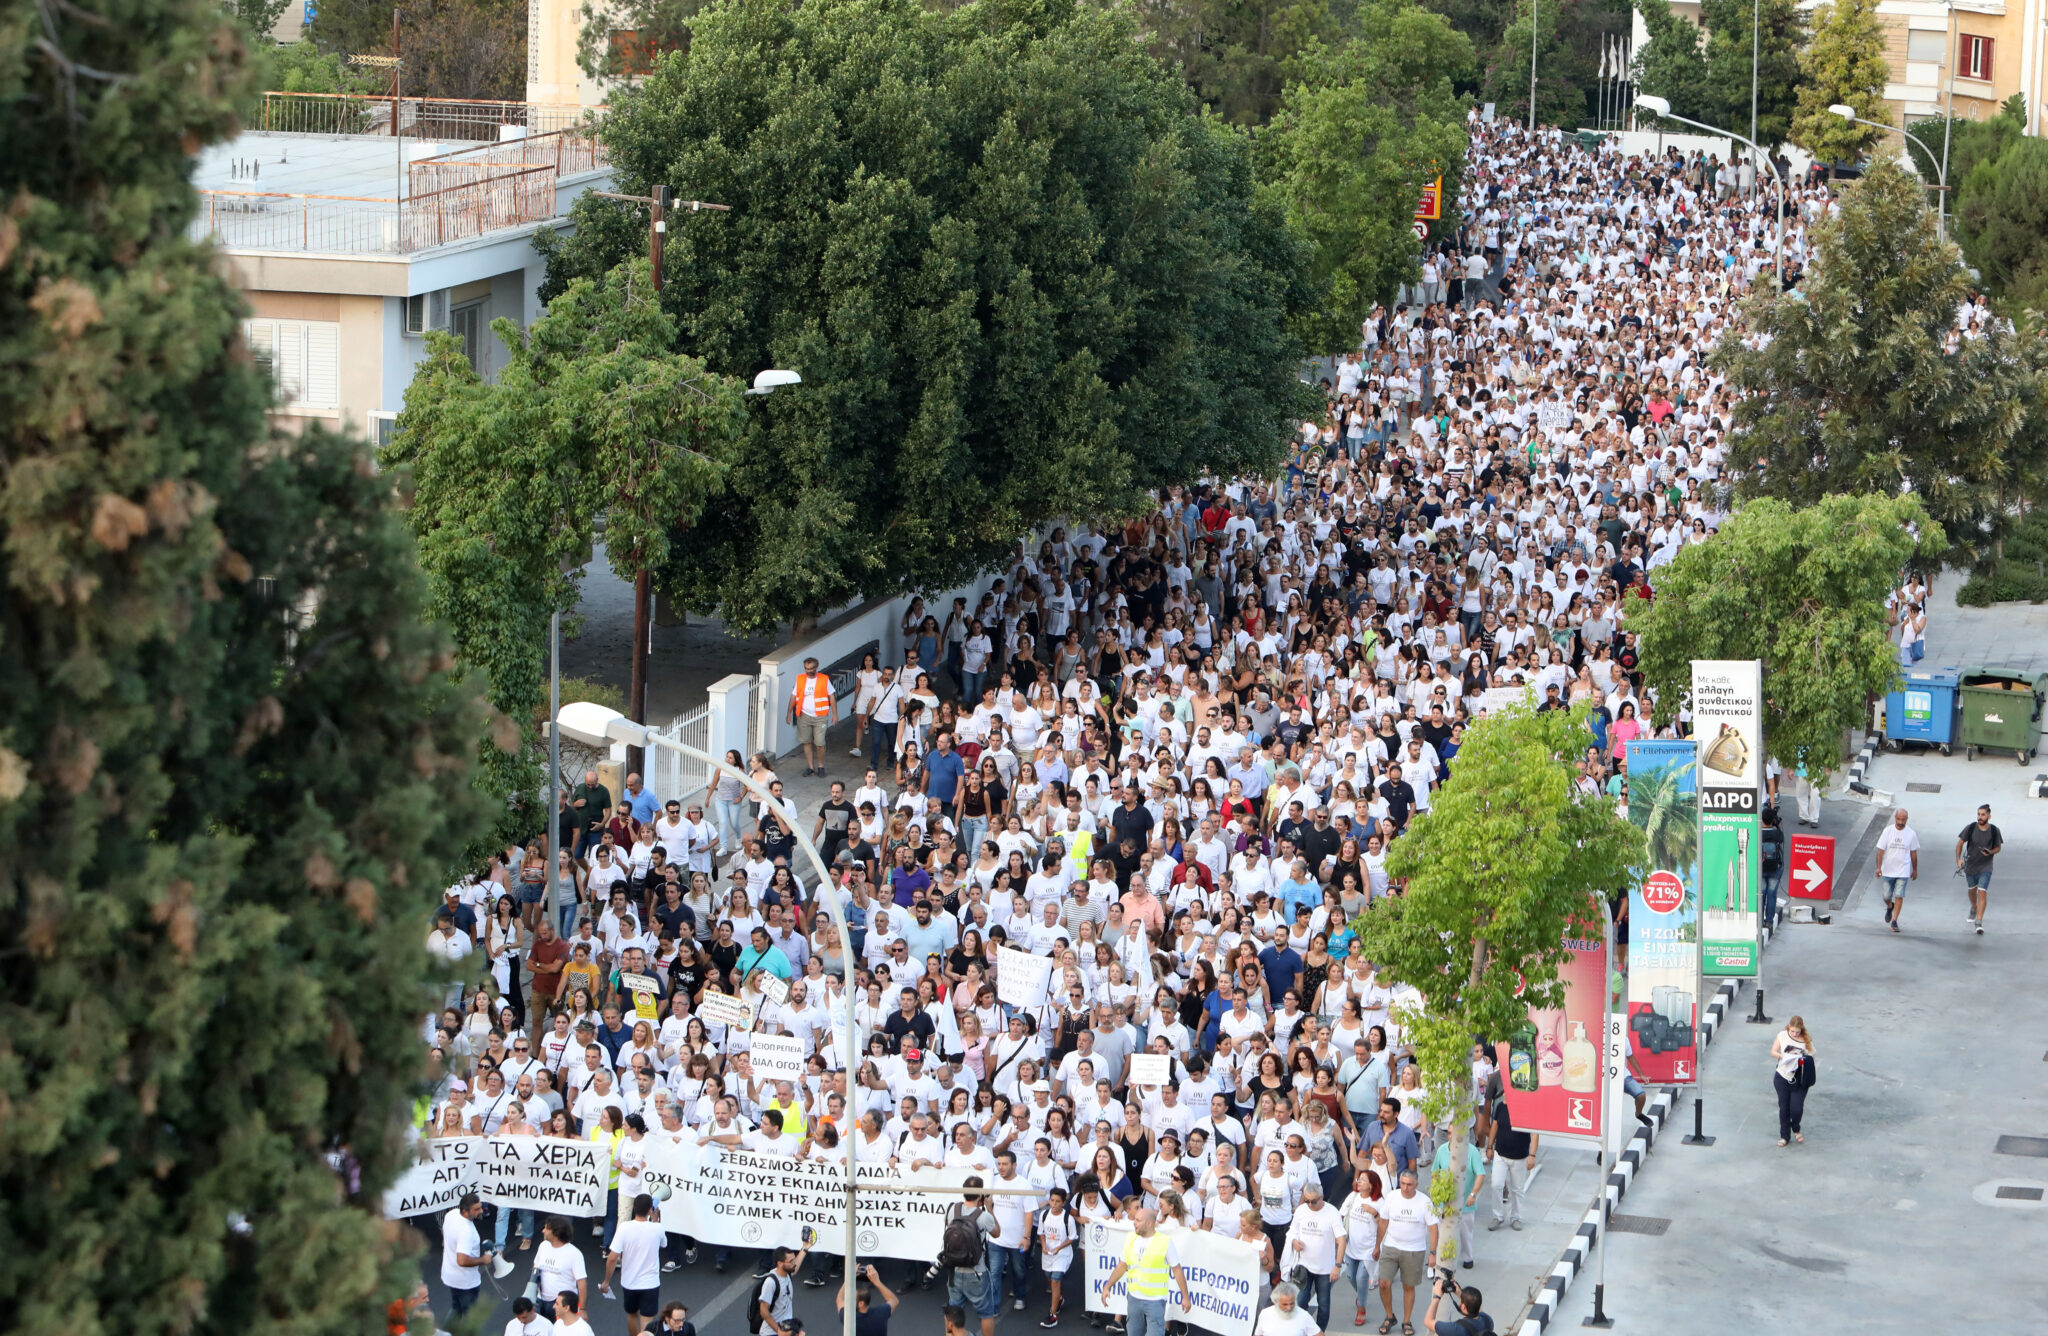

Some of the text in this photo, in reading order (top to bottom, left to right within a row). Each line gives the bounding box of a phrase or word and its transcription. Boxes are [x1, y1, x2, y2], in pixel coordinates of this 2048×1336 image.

[1698, 676, 1710, 684] Με
[1698, 686, 1734, 696] αλλαγή
[1698, 697, 1752, 705] συνθετικού
[1698, 707, 1752, 716] λιπαντικού
[1643, 747, 1690, 755] Ellehammer
[1703, 791, 1753, 809] ΔΩΡΟ
[1703, 814, 1753, 823] ολυχρηστικό
[1646, 887, 1680, 899] 71%
[1641, 928, 1685, 940] Η ΖΩΗ
[1561, 939, 1600, 951] SWEEP
[1644, 942, 1683, 953] ΕΙΝΑΙ
[1724, 957, 1747, 965] Castrol
[489, 1142, 520, 1161] ΤΑ
[533, 1143, 595, 1169] ΧΕΡΙΑ
[720, 1153, 803, 1173] ΣΕΒΑΣΜΟΣ
[808, 1163, 838, 1177] ΣΤΑ
[476, 1162, 515, 1176] ΤΗΝ
[528, 1166, 600, 1188] ΠΑΙΔΕΙΑ
[699, 1166, 723, 1180] ΚΑΙ
[728, 1171, 777, 1186] ΣΤΟΥΣ
[645, 1171, 671, 1184] ΟΧΙ
[675, 1178, 703, 1194] ΣΤΗ
[707, 1185, 774, 1202] ΔΙΑΛΥΣΗ
[779, 1192, 808, 1206] ΤΗΣ
[907, 1202, 946, 1215] ΠΑΙΔ
[714, 1203, 783, 1220] ΟΕΛΜΕΚ
[1189, 1292, 1249, 1321] ΜΕΣΑΙΩΝΑ
